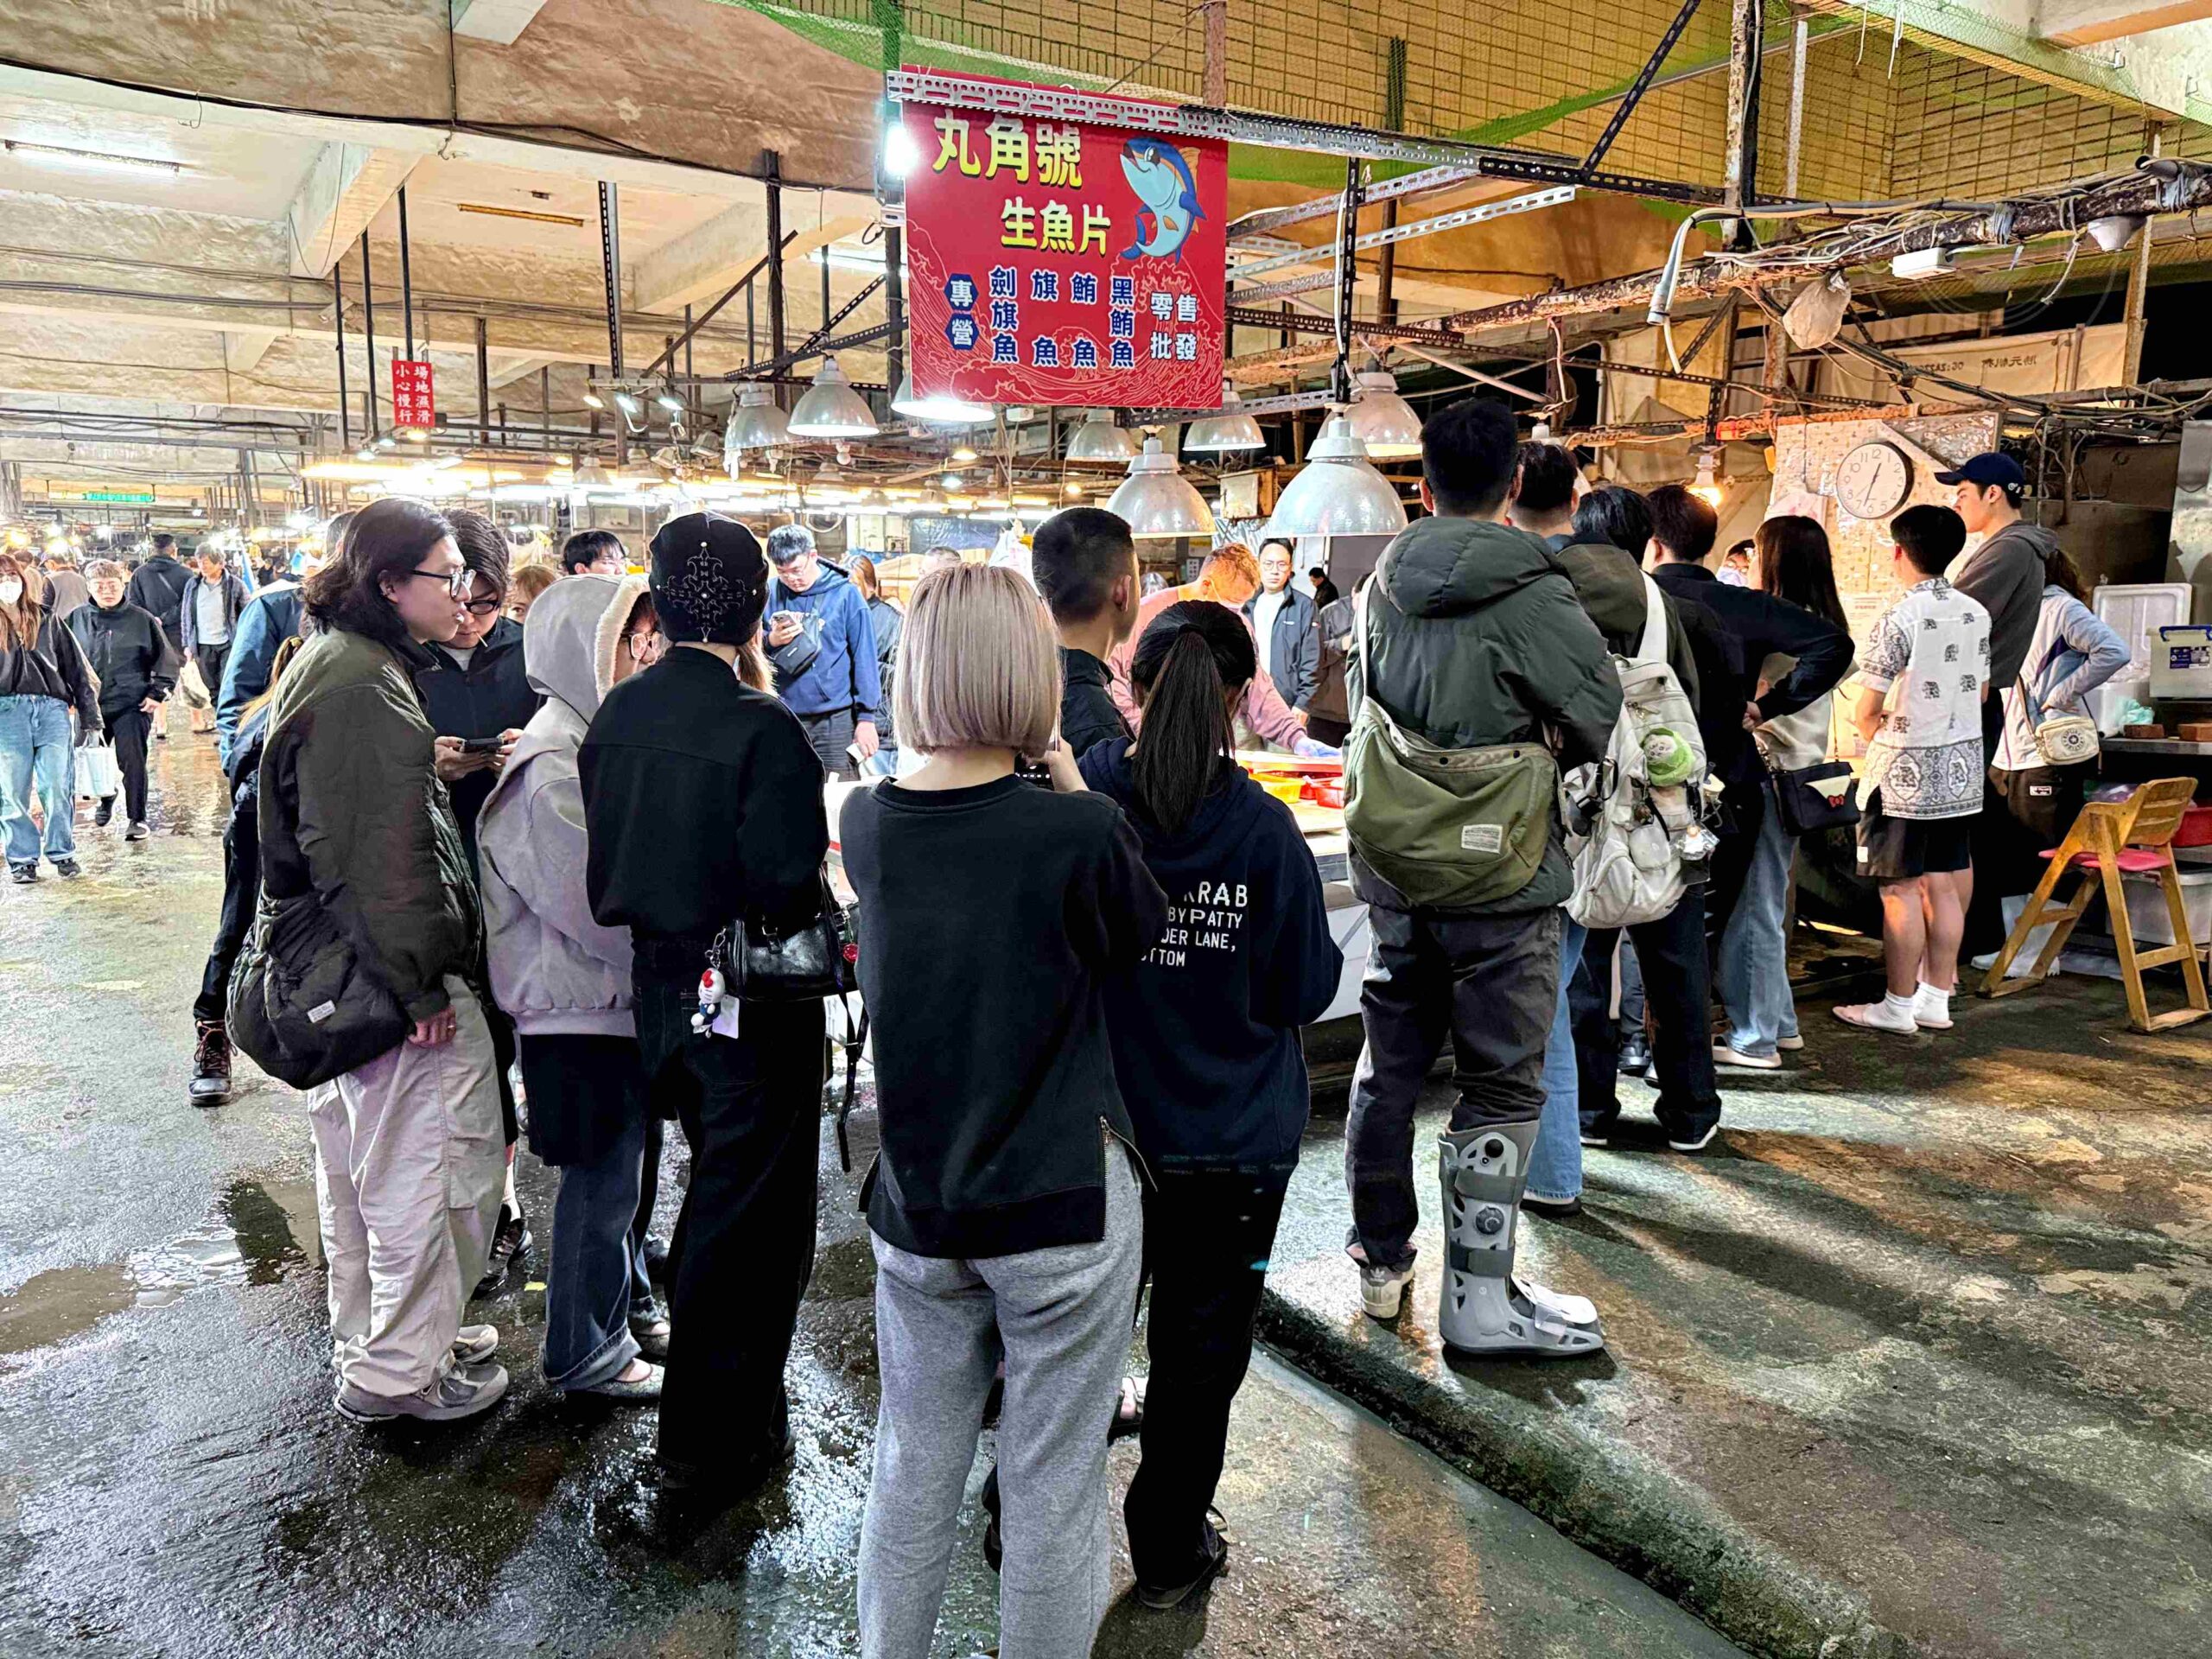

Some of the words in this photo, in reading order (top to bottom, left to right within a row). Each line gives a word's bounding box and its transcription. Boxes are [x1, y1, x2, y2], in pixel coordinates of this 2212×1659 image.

[932, 110, 1083, 188] 丸角號
[1001, 196, 1111, 255] 生魚片
[950, 279, 975, 346] 專營
[990, 266, 1018, 363] 劍旗魚
[1110, 276, 1135, 368] 黑鮪魚
[1150, 292, 1198, 322] 零售
[1150, 332, 1198, 361] 批發
[396, 364, 413, 423] 小心慢行
[414, 365, 431, 423] 場地濕滑
[1141, 948, 1185, 967] TTOM
[1195, 931, 1236, 952] LANE,
